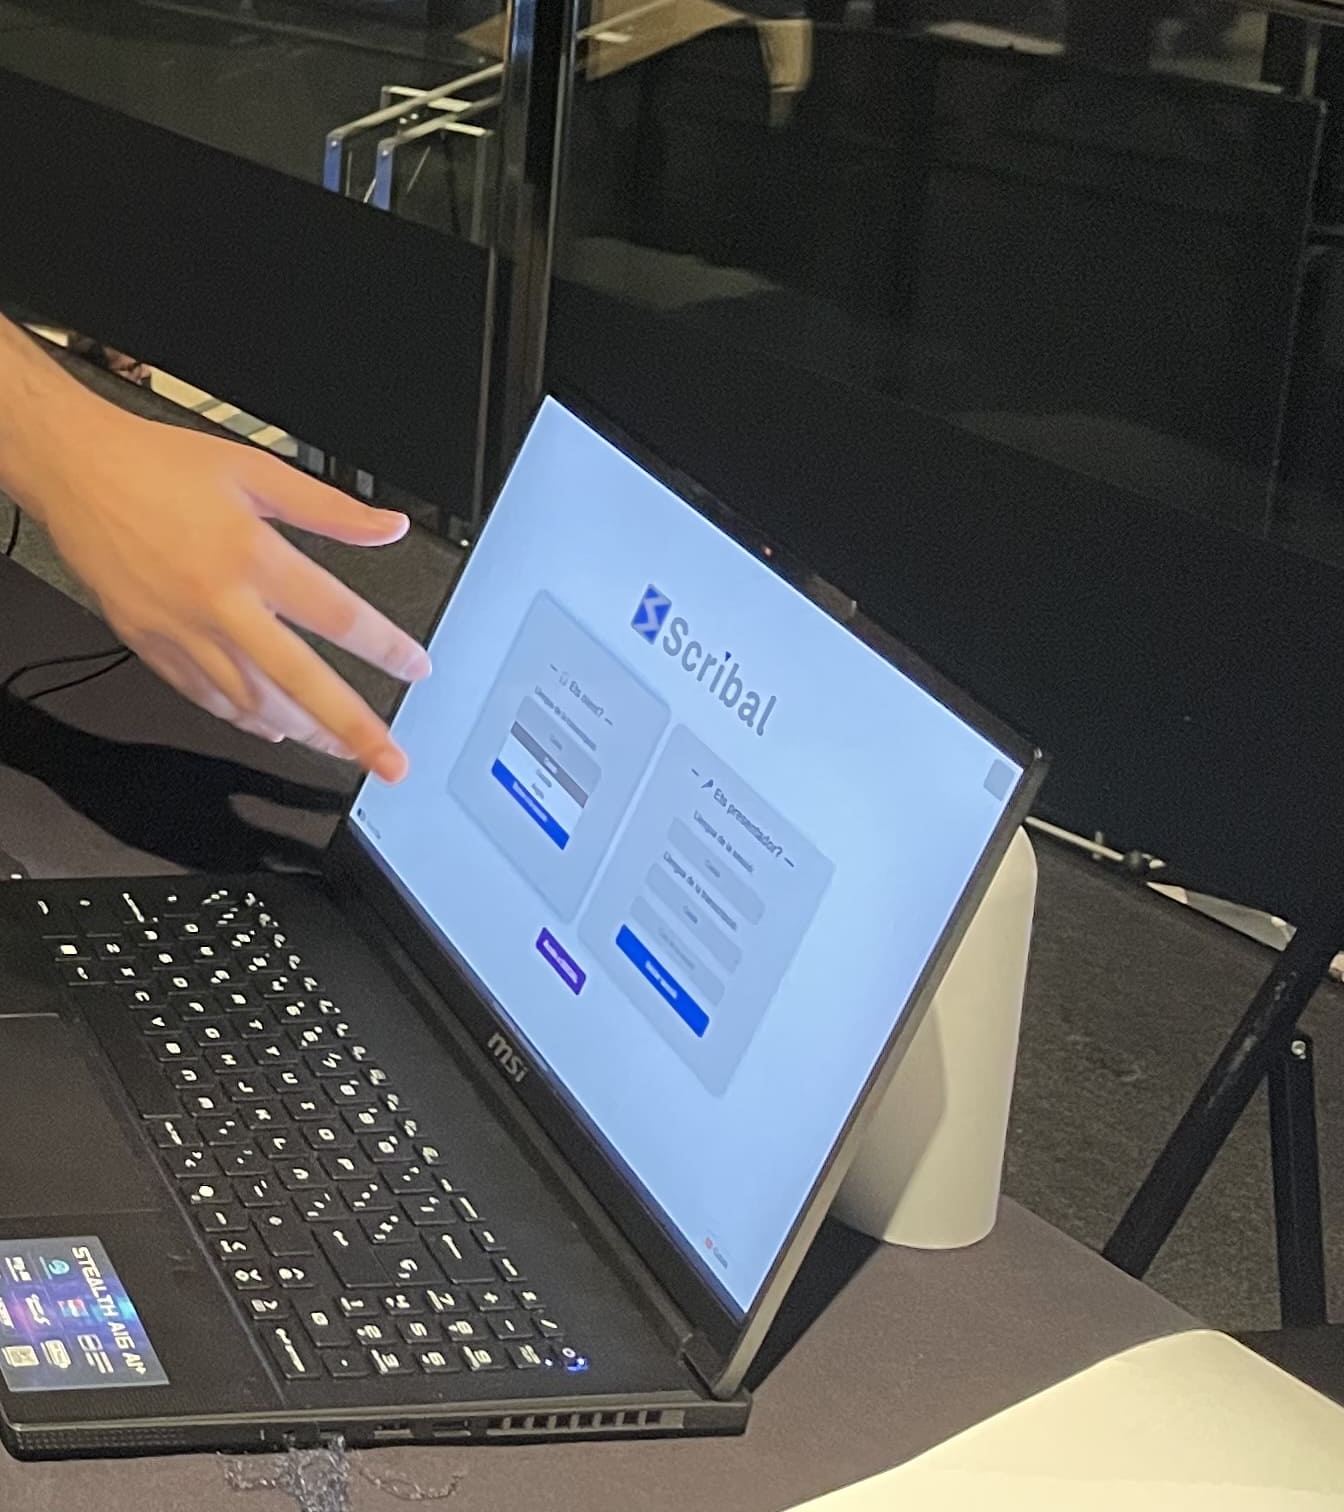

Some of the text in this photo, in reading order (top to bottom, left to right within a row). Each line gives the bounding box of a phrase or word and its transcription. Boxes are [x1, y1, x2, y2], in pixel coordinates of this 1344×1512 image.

[661, 614, 779, 738] Scribal
[488, 1032, 529, 1083] msi
[72, 1246, 120, 1318] STEALTH
